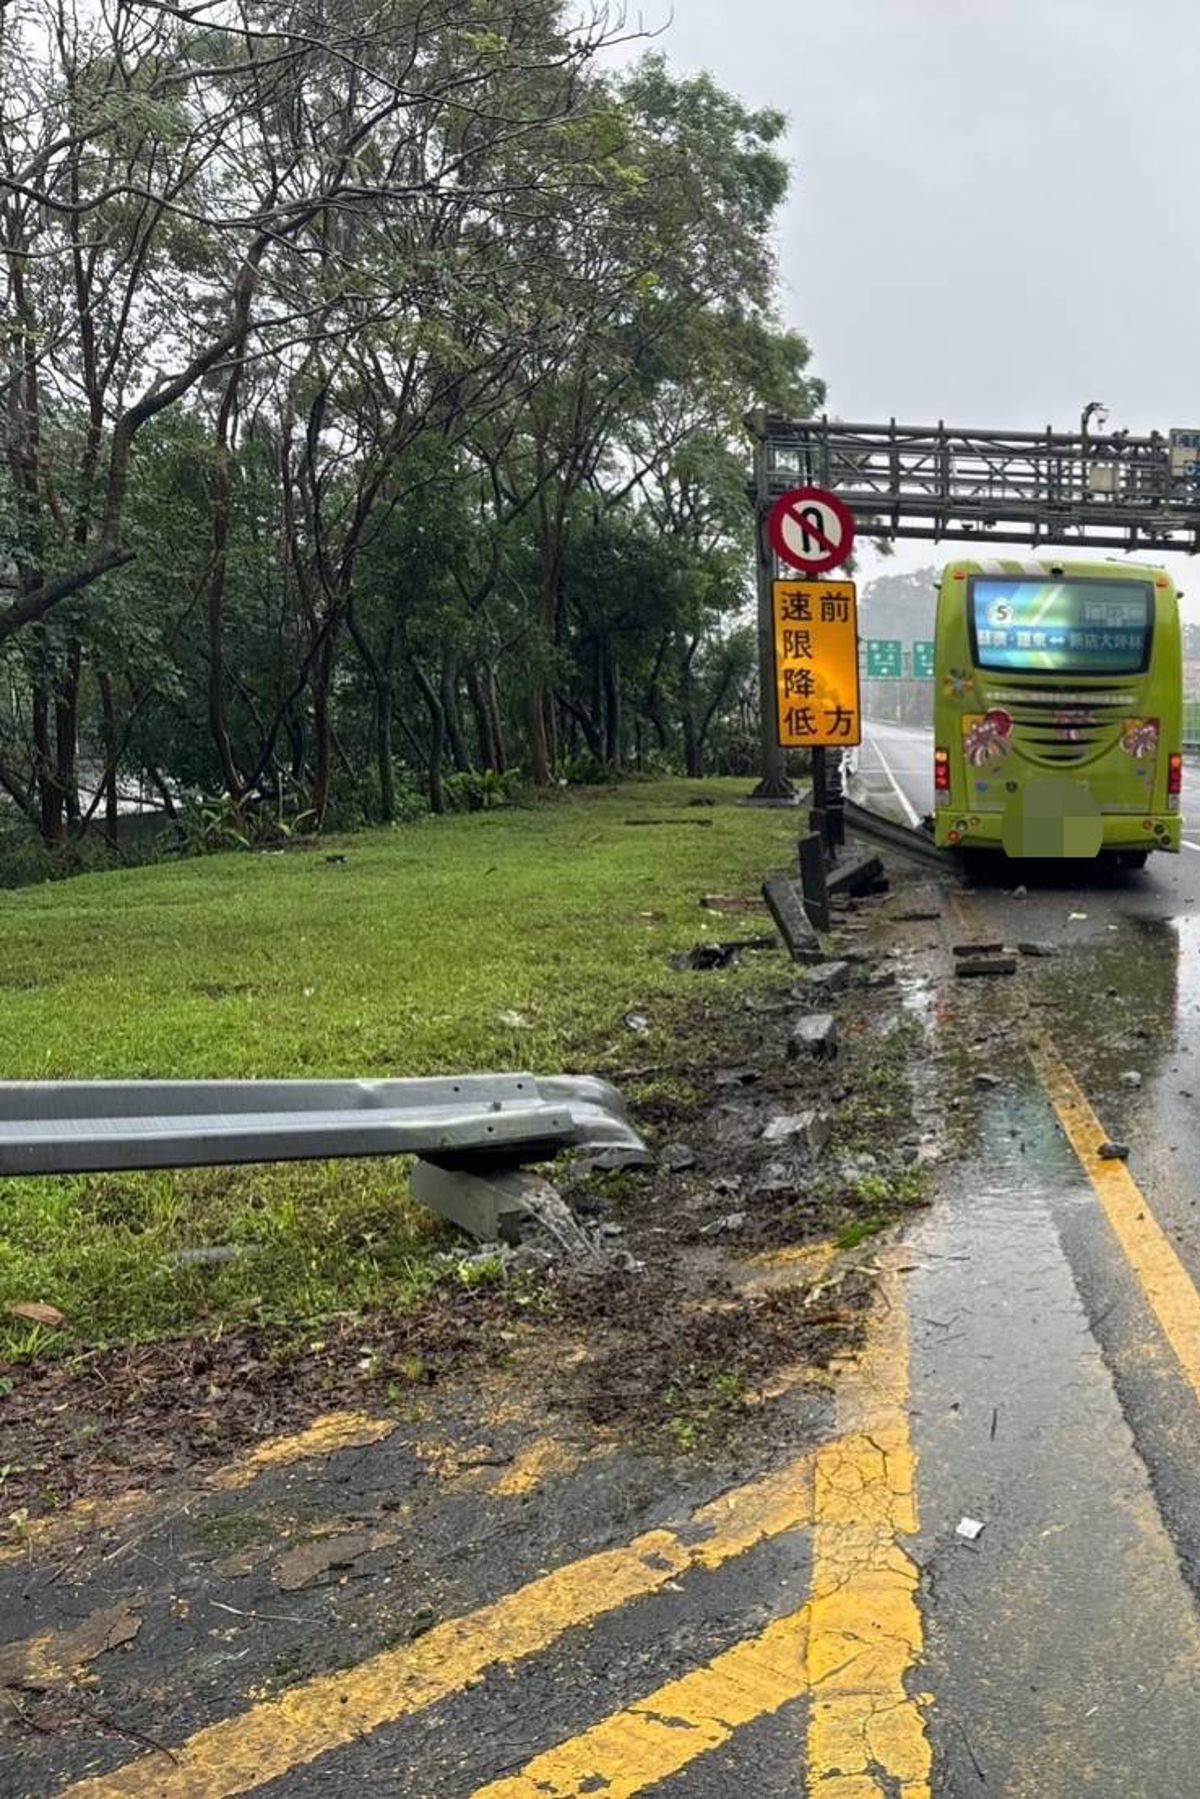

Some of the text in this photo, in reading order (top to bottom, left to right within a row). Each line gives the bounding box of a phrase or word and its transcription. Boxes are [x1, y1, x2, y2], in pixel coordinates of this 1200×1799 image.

[781, 590, 817, 737] 速限降低
[819, 591, 855, 736] 前方
[996, 605, 1008, 621] 5
